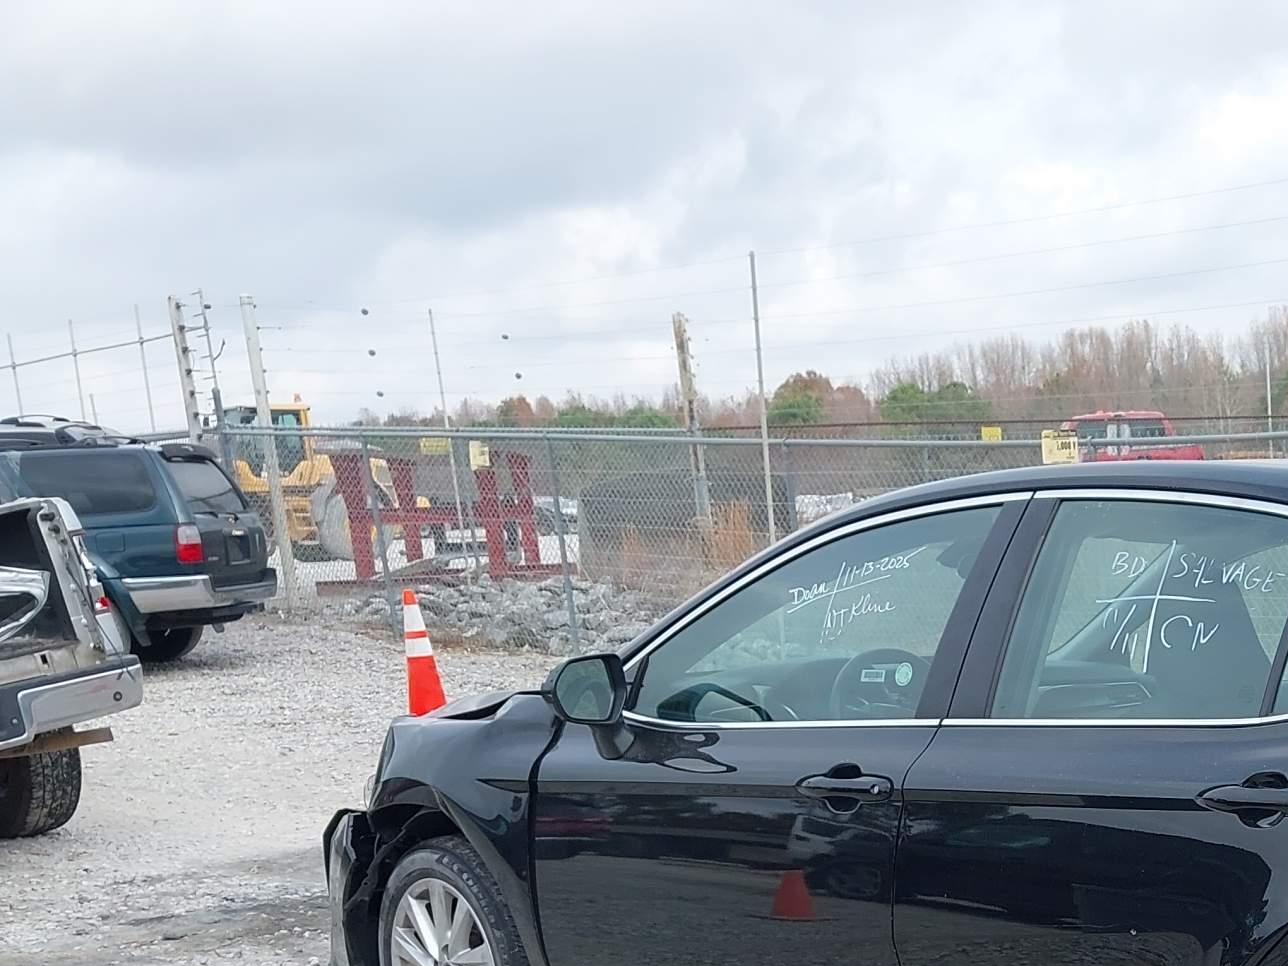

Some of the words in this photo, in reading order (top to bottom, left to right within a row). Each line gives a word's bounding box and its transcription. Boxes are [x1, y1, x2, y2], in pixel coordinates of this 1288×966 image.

[842, 548, 922, 586] 11-13-2025
[1112, 552, 1145, 577] BD
[1161, 615, 1219, 651] CN
